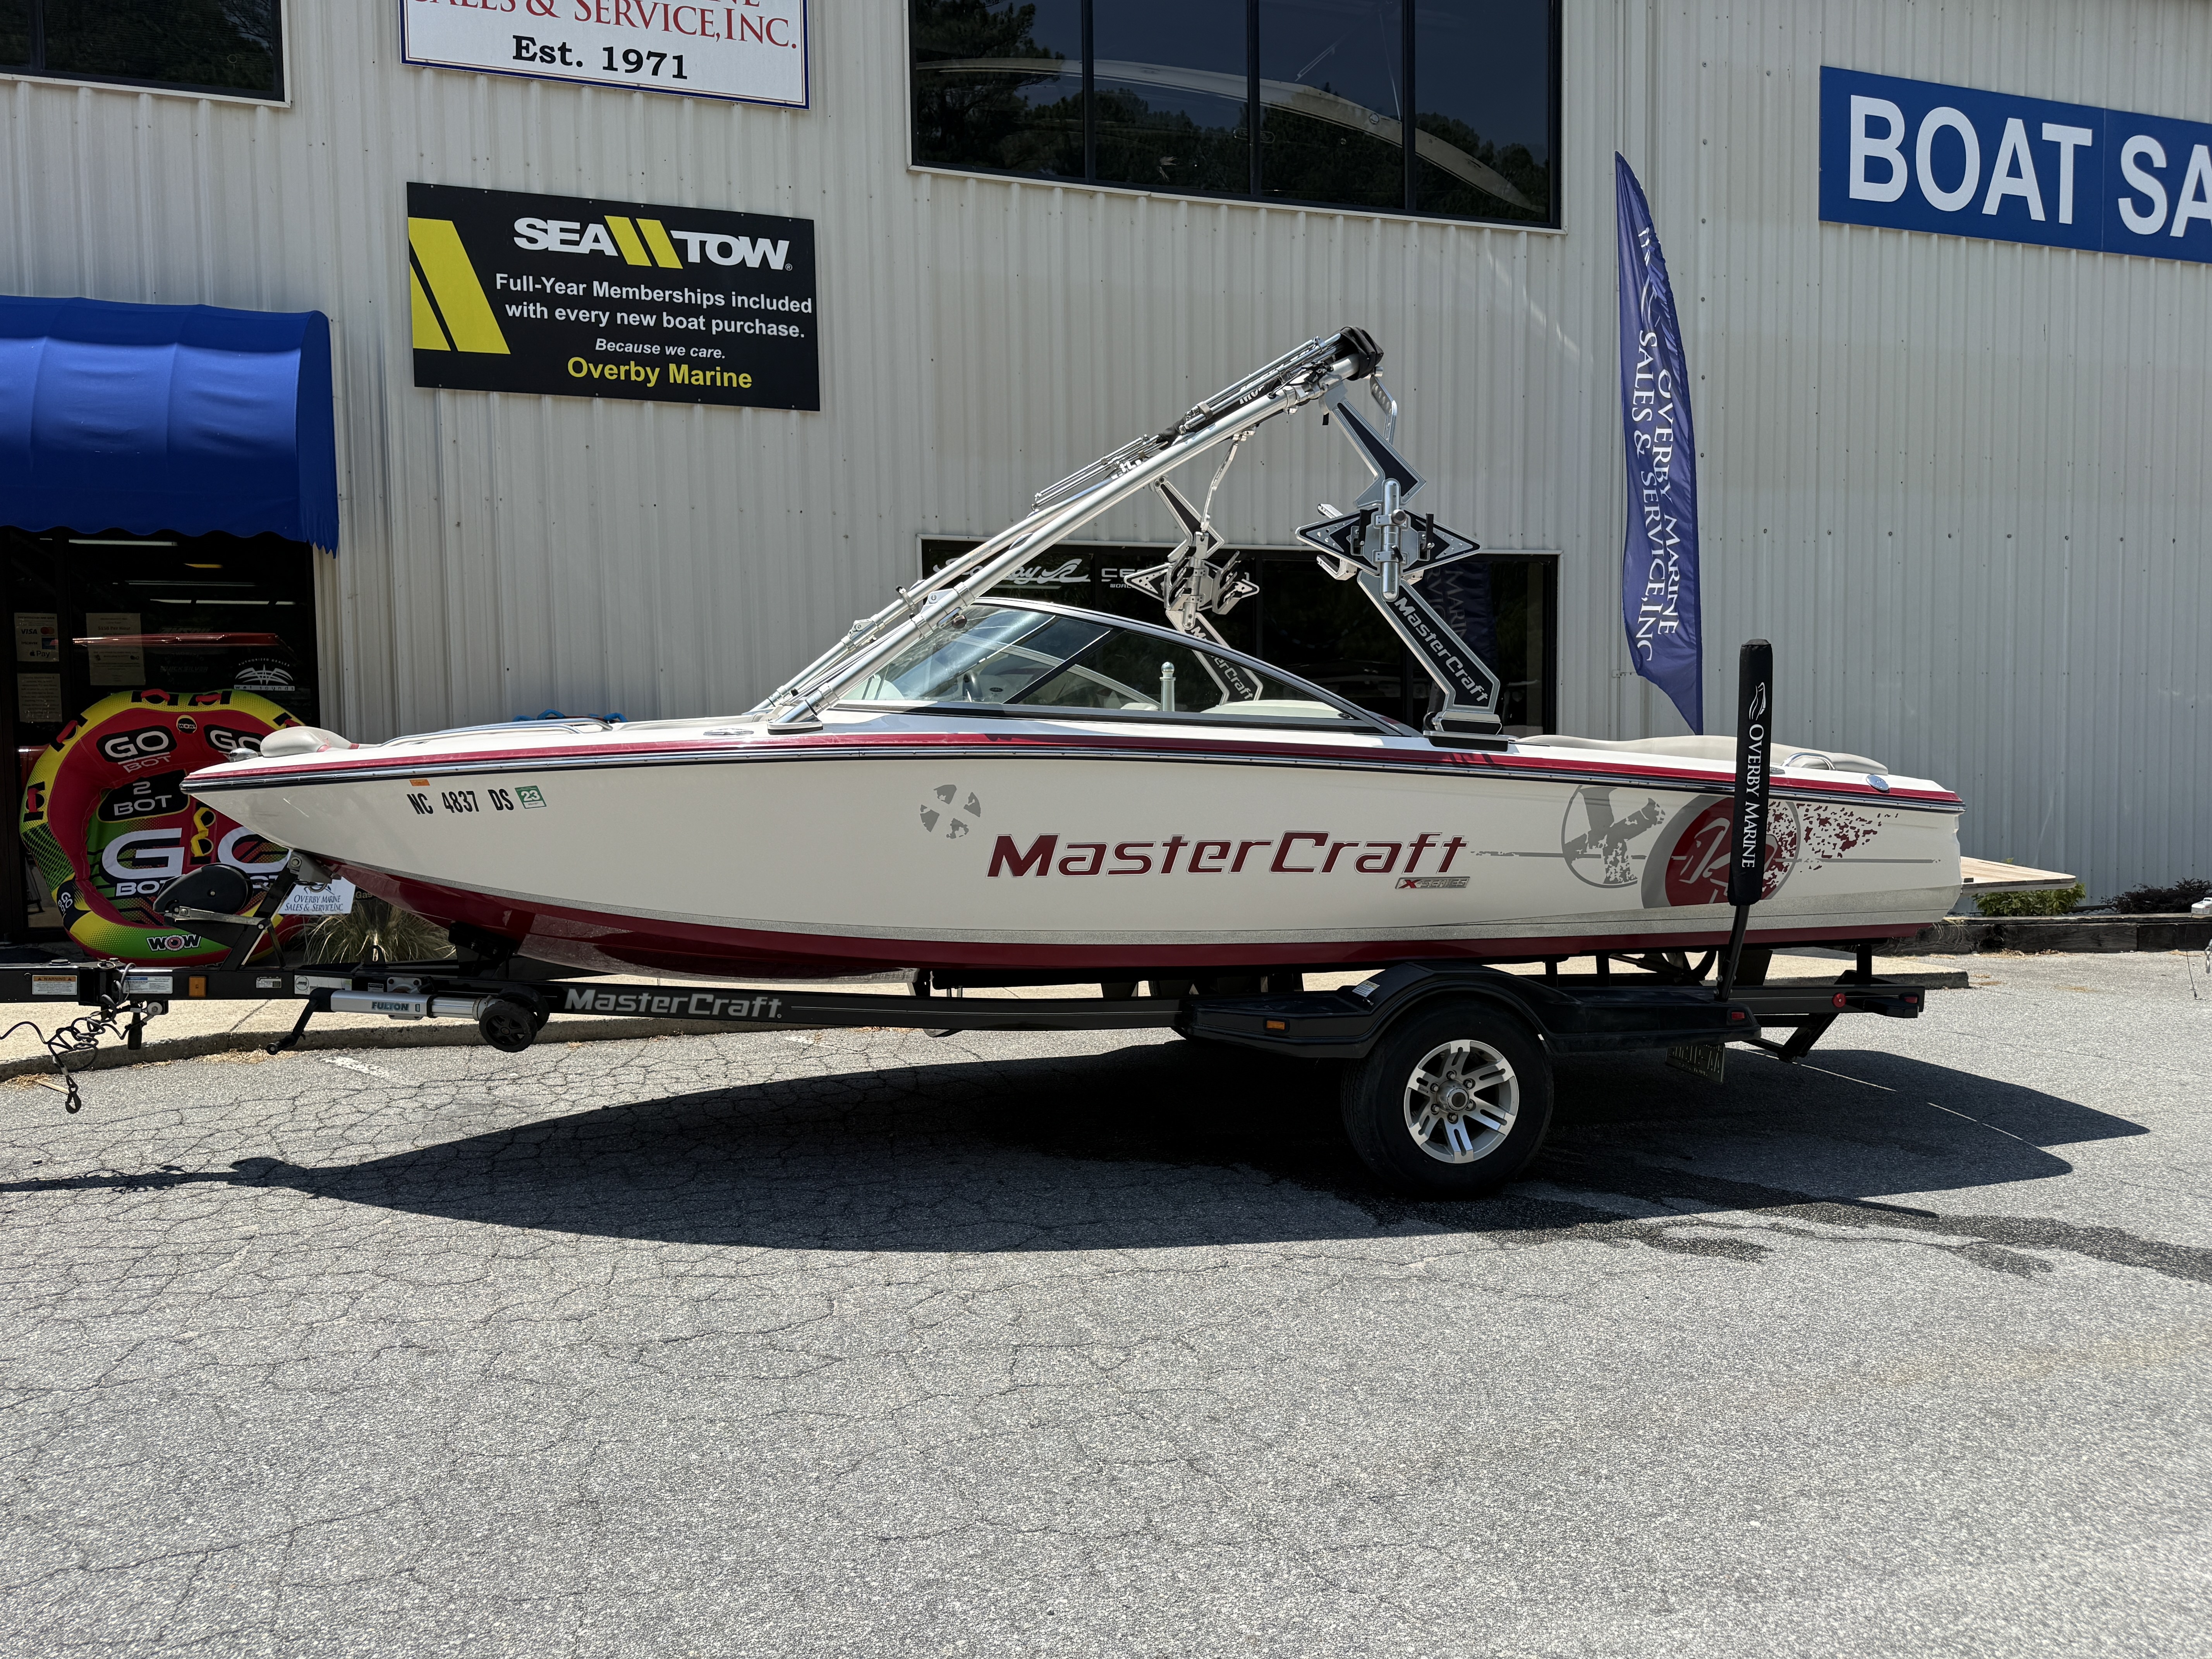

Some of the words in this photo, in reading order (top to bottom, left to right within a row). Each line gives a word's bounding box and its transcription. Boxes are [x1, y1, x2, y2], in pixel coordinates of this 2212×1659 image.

[513, 35, 583, 67] Est.
[603, 46, 688, 80] 1971
[1850, 94, 2093, 225] BOAT
[514, 217, 619, 256] SEA
[496, 273, 587, 296] Full-Year
[593, 280, 725, 309] Memberships
[732, 291, 812, 314] included
[505, 301, 548, 319] with
[555, 307, 610, 328] every
[617, 309, 656, 328] new
[662, 311, 706, 330] boat
[711, 318, 805, 338] purchase.
[595, 338, 661, 354] Because
[665, 345, 686, 356] we
[690, 347, 725, 359] care.
[567, 357, 660, 387] Overby
[669, 363, 752, 388] Marine
[1632, 330, 1658, 422] SALES
[1634, 430, 1651, 459] &
[1652, 369, 1674, 504] OVERBY
[1658, 512, 1680, 635] MARINE
[1394, 596, 1489, 703] MasterCraft
[105, 731, 169, 758] GO
[211, 730, 262, 751] GO
[123, 755, 172, 773] BOT
[1746, 724, 1765, 794] OVERBY
[132, 781, 152, 795] 2
[407, 793, 433, 815] NC
[441, 790, 480, 813] 4837
[487, 788, 514, 811] DS
[520, 790, 541, 802] 23
[113, 795, 172, 816] BOT
[1741, 801, 1760, 868] MARINE
[986, 830, 1470, 879] MasterCraft
[61, 892, 73, 909] GO
[285, 903, 303, 911] SALES
[304, 903, 310, 911] &
[294, 895, 321, 903] OVERBY
[321, 895, 341, 903] MARINE
[146, 934, 201, 951] WOW
[371, 1001, 410, 1012] FULTON
